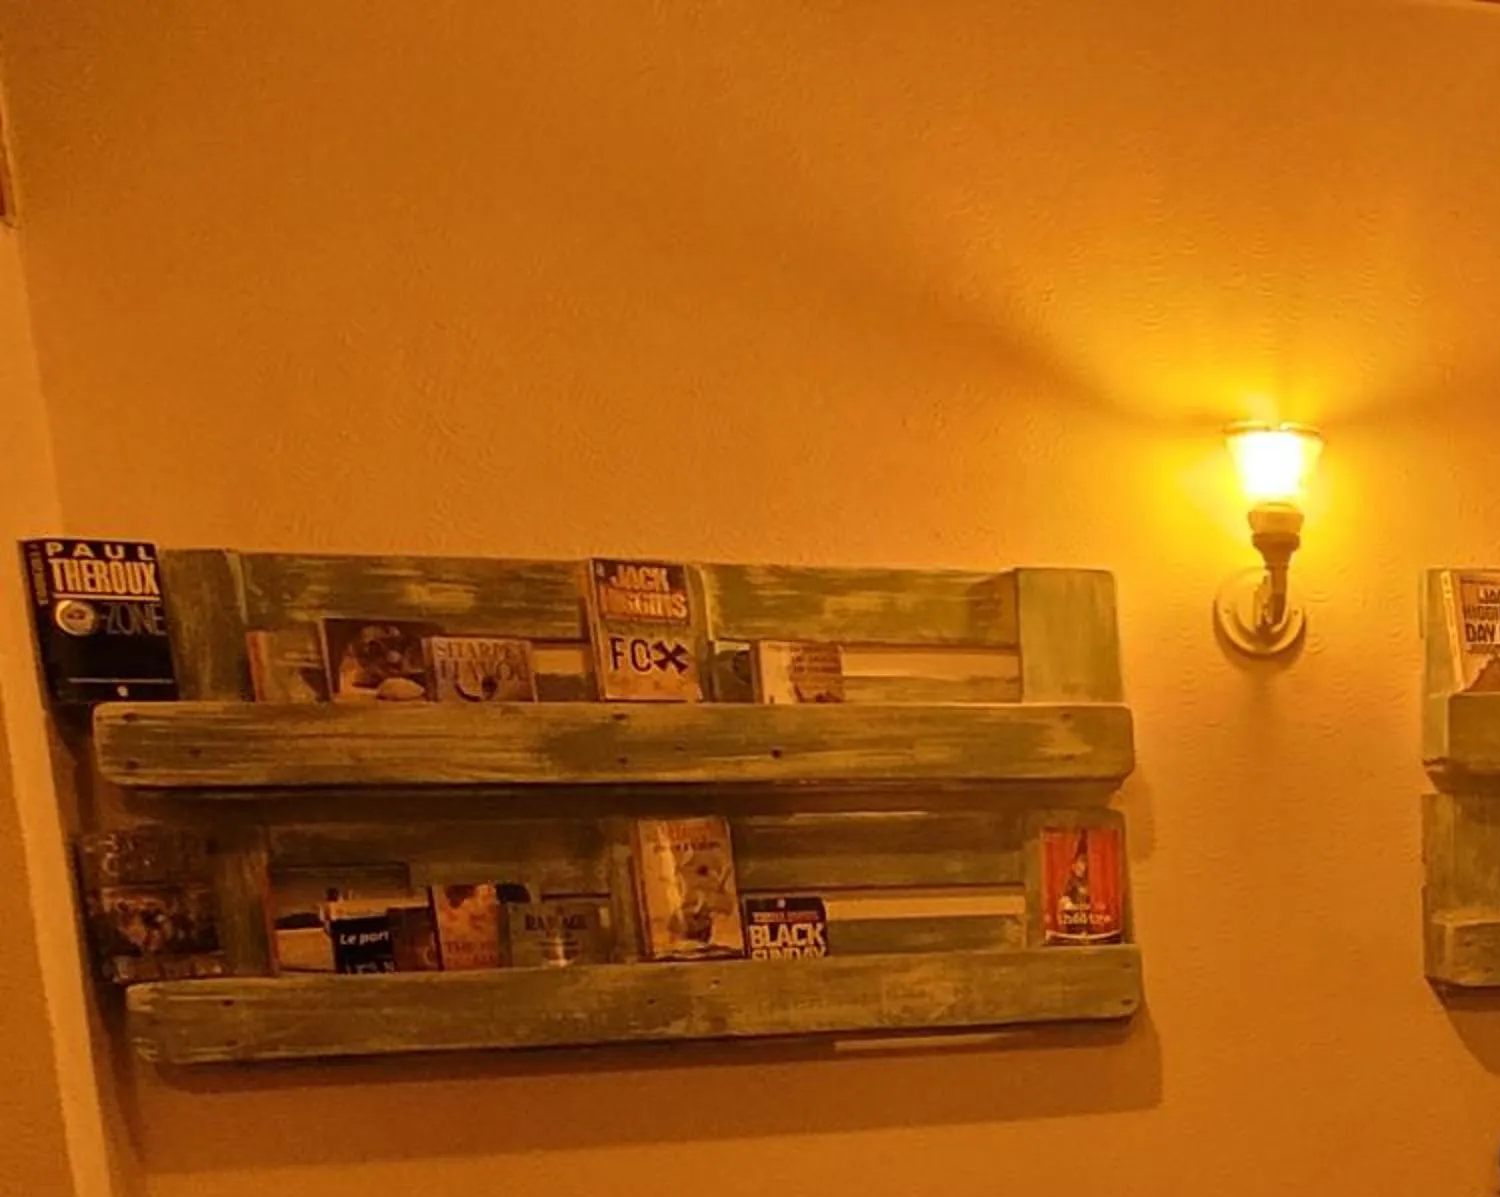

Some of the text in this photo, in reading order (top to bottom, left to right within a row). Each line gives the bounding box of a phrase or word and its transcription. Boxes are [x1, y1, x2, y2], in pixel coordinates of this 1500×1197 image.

[44, 541, 155, 561] PAUL
[48, 558, 160, 595] THEROUX
[609, 564, 670, 592] JACK
[1465, 623, 1496, 643] DAY
[609, 635, 689, 674] FOX
[749, 922, 825, 947] BLACK
